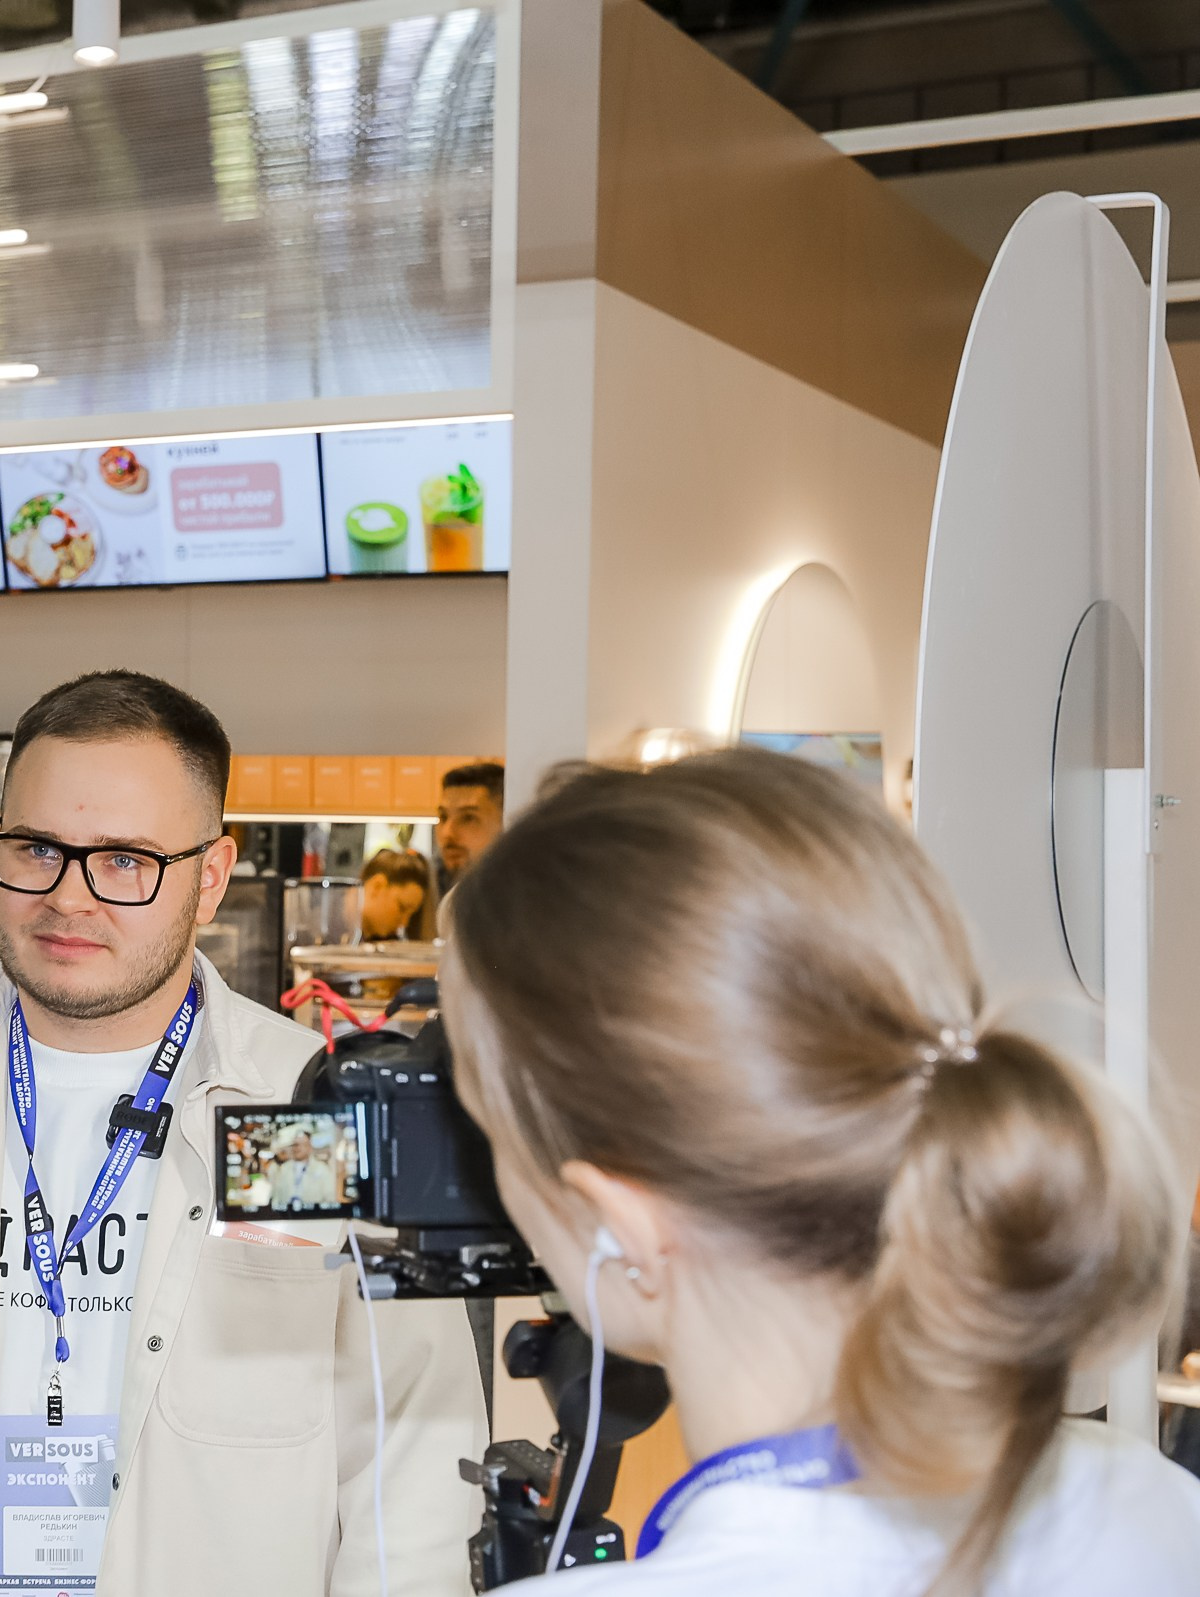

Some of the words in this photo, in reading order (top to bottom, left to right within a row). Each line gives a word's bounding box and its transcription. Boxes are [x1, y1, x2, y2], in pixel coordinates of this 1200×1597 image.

[13, 1048, 22, 1080] ВАШЕМУ
[15, 1082, 27, 1127] ЗДОРОВЬЮ
[96, 1178, 118, 1211] ВРЕДИТ
[114, 1141, 136, 1177] ВАШЕМУ
[10, 1292, 51, 1311] КОФ
[7, 1472, 97, 1486] ЭКСПОНЕНТ
[12, 1513, 61, 1521] ВЛАДИСЛАВ
[63, 1513, 106, 1521] ИГОРЕВИЧ
[40, 1523, 78, 1531] РЕДЬКИН
